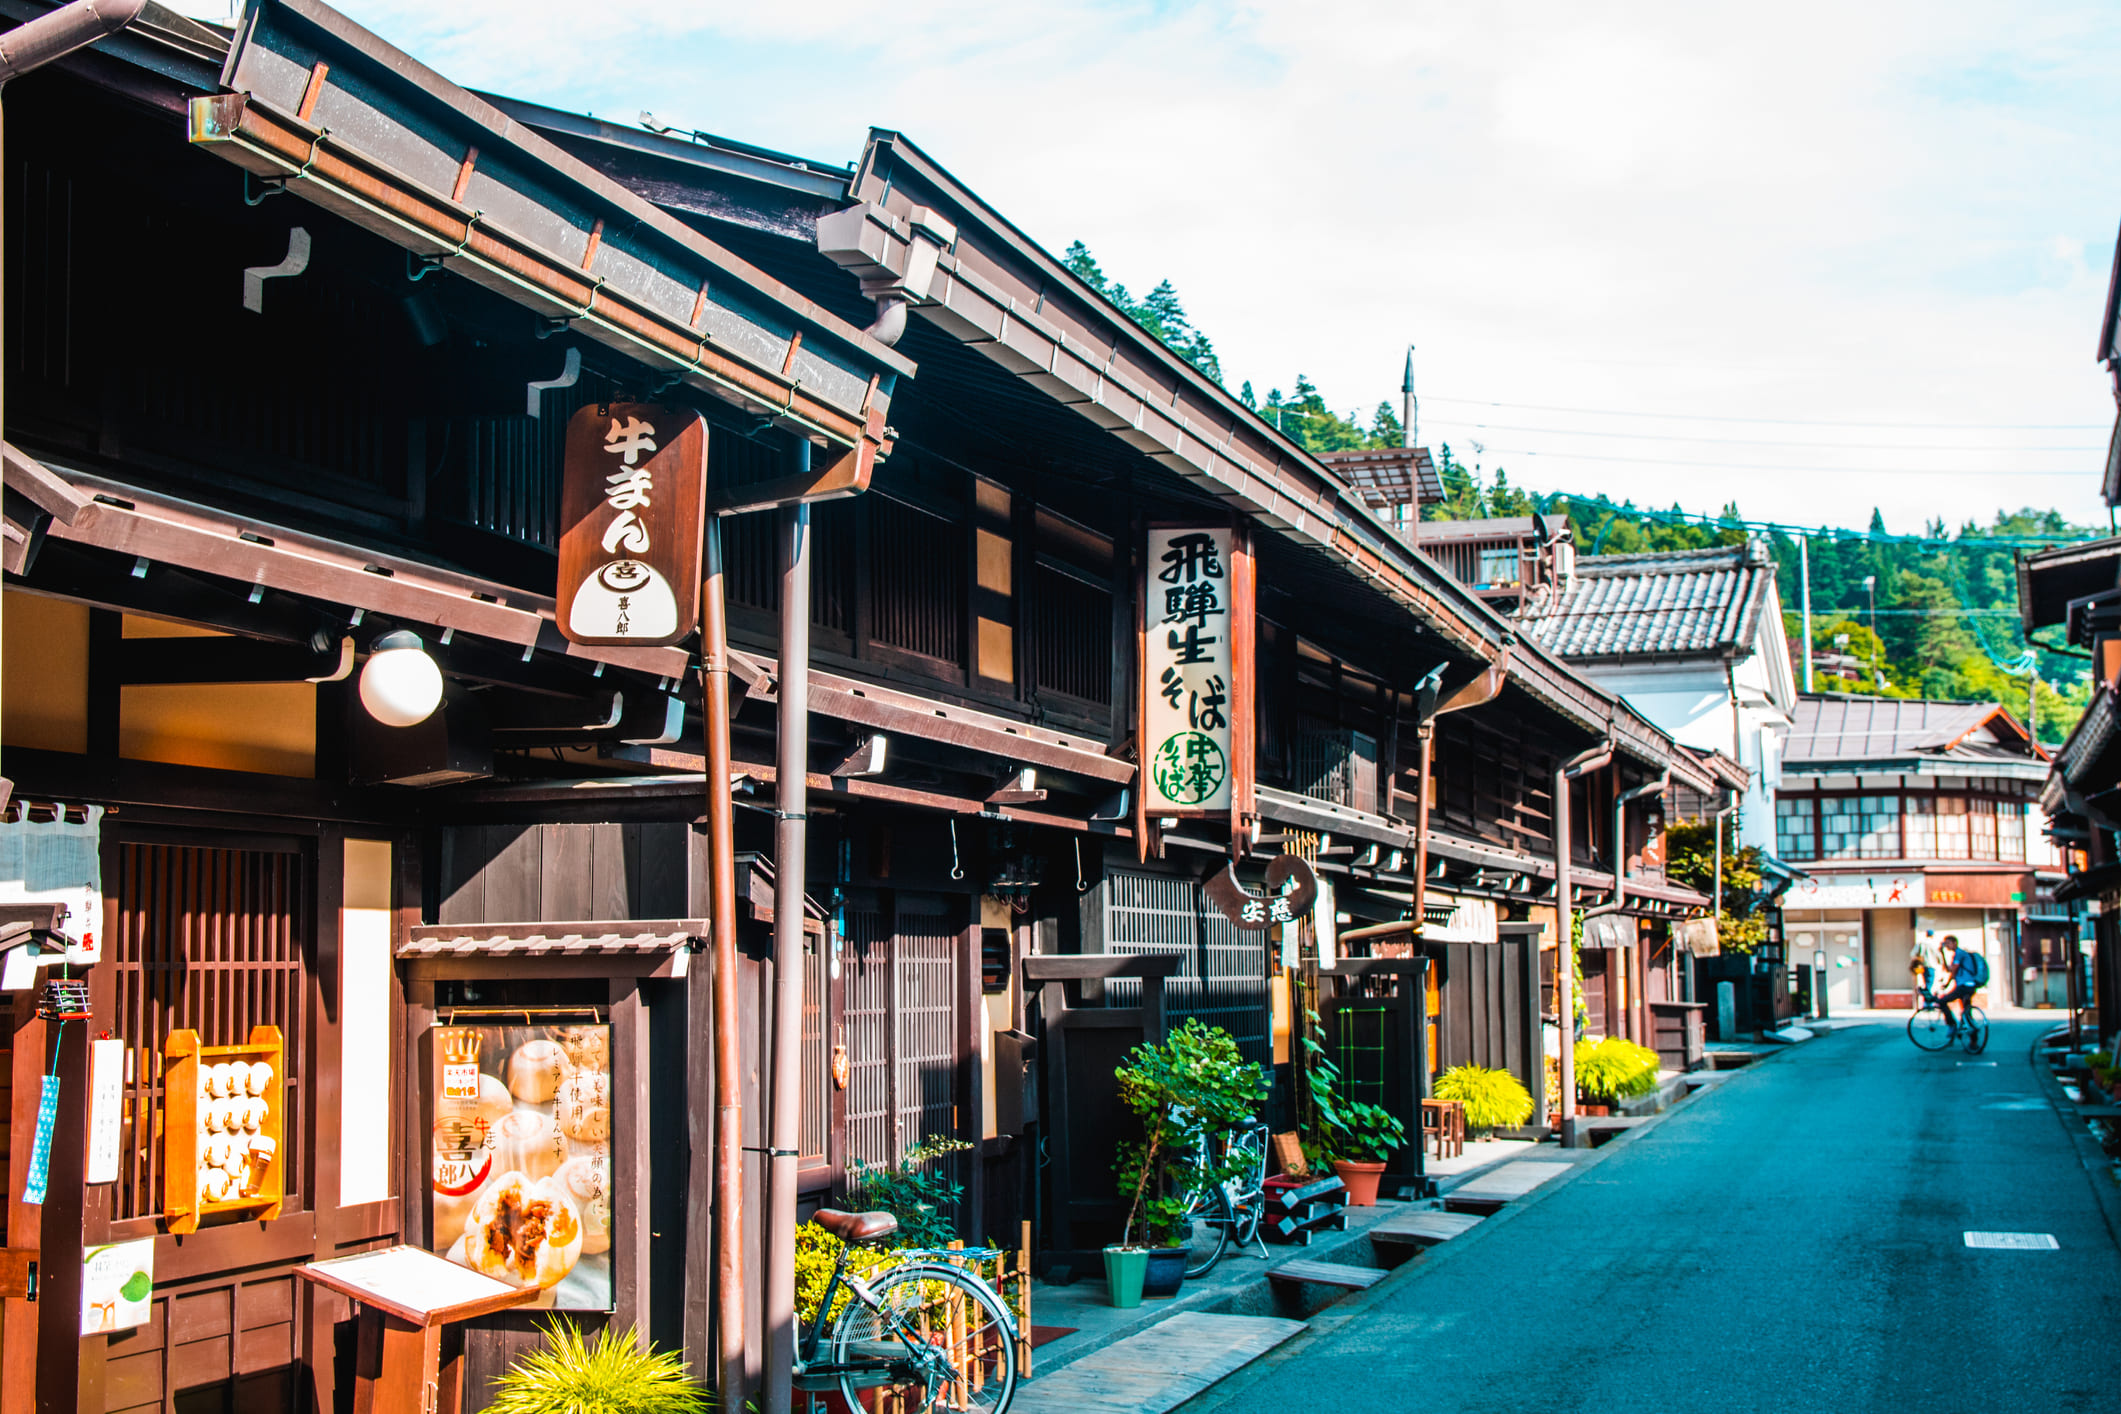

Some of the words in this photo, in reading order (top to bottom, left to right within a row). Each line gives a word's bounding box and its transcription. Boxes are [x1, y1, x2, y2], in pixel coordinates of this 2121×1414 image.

[601, 416, 657, 554] 牛まん
[616, 596, 631, 635] 喜八郎
